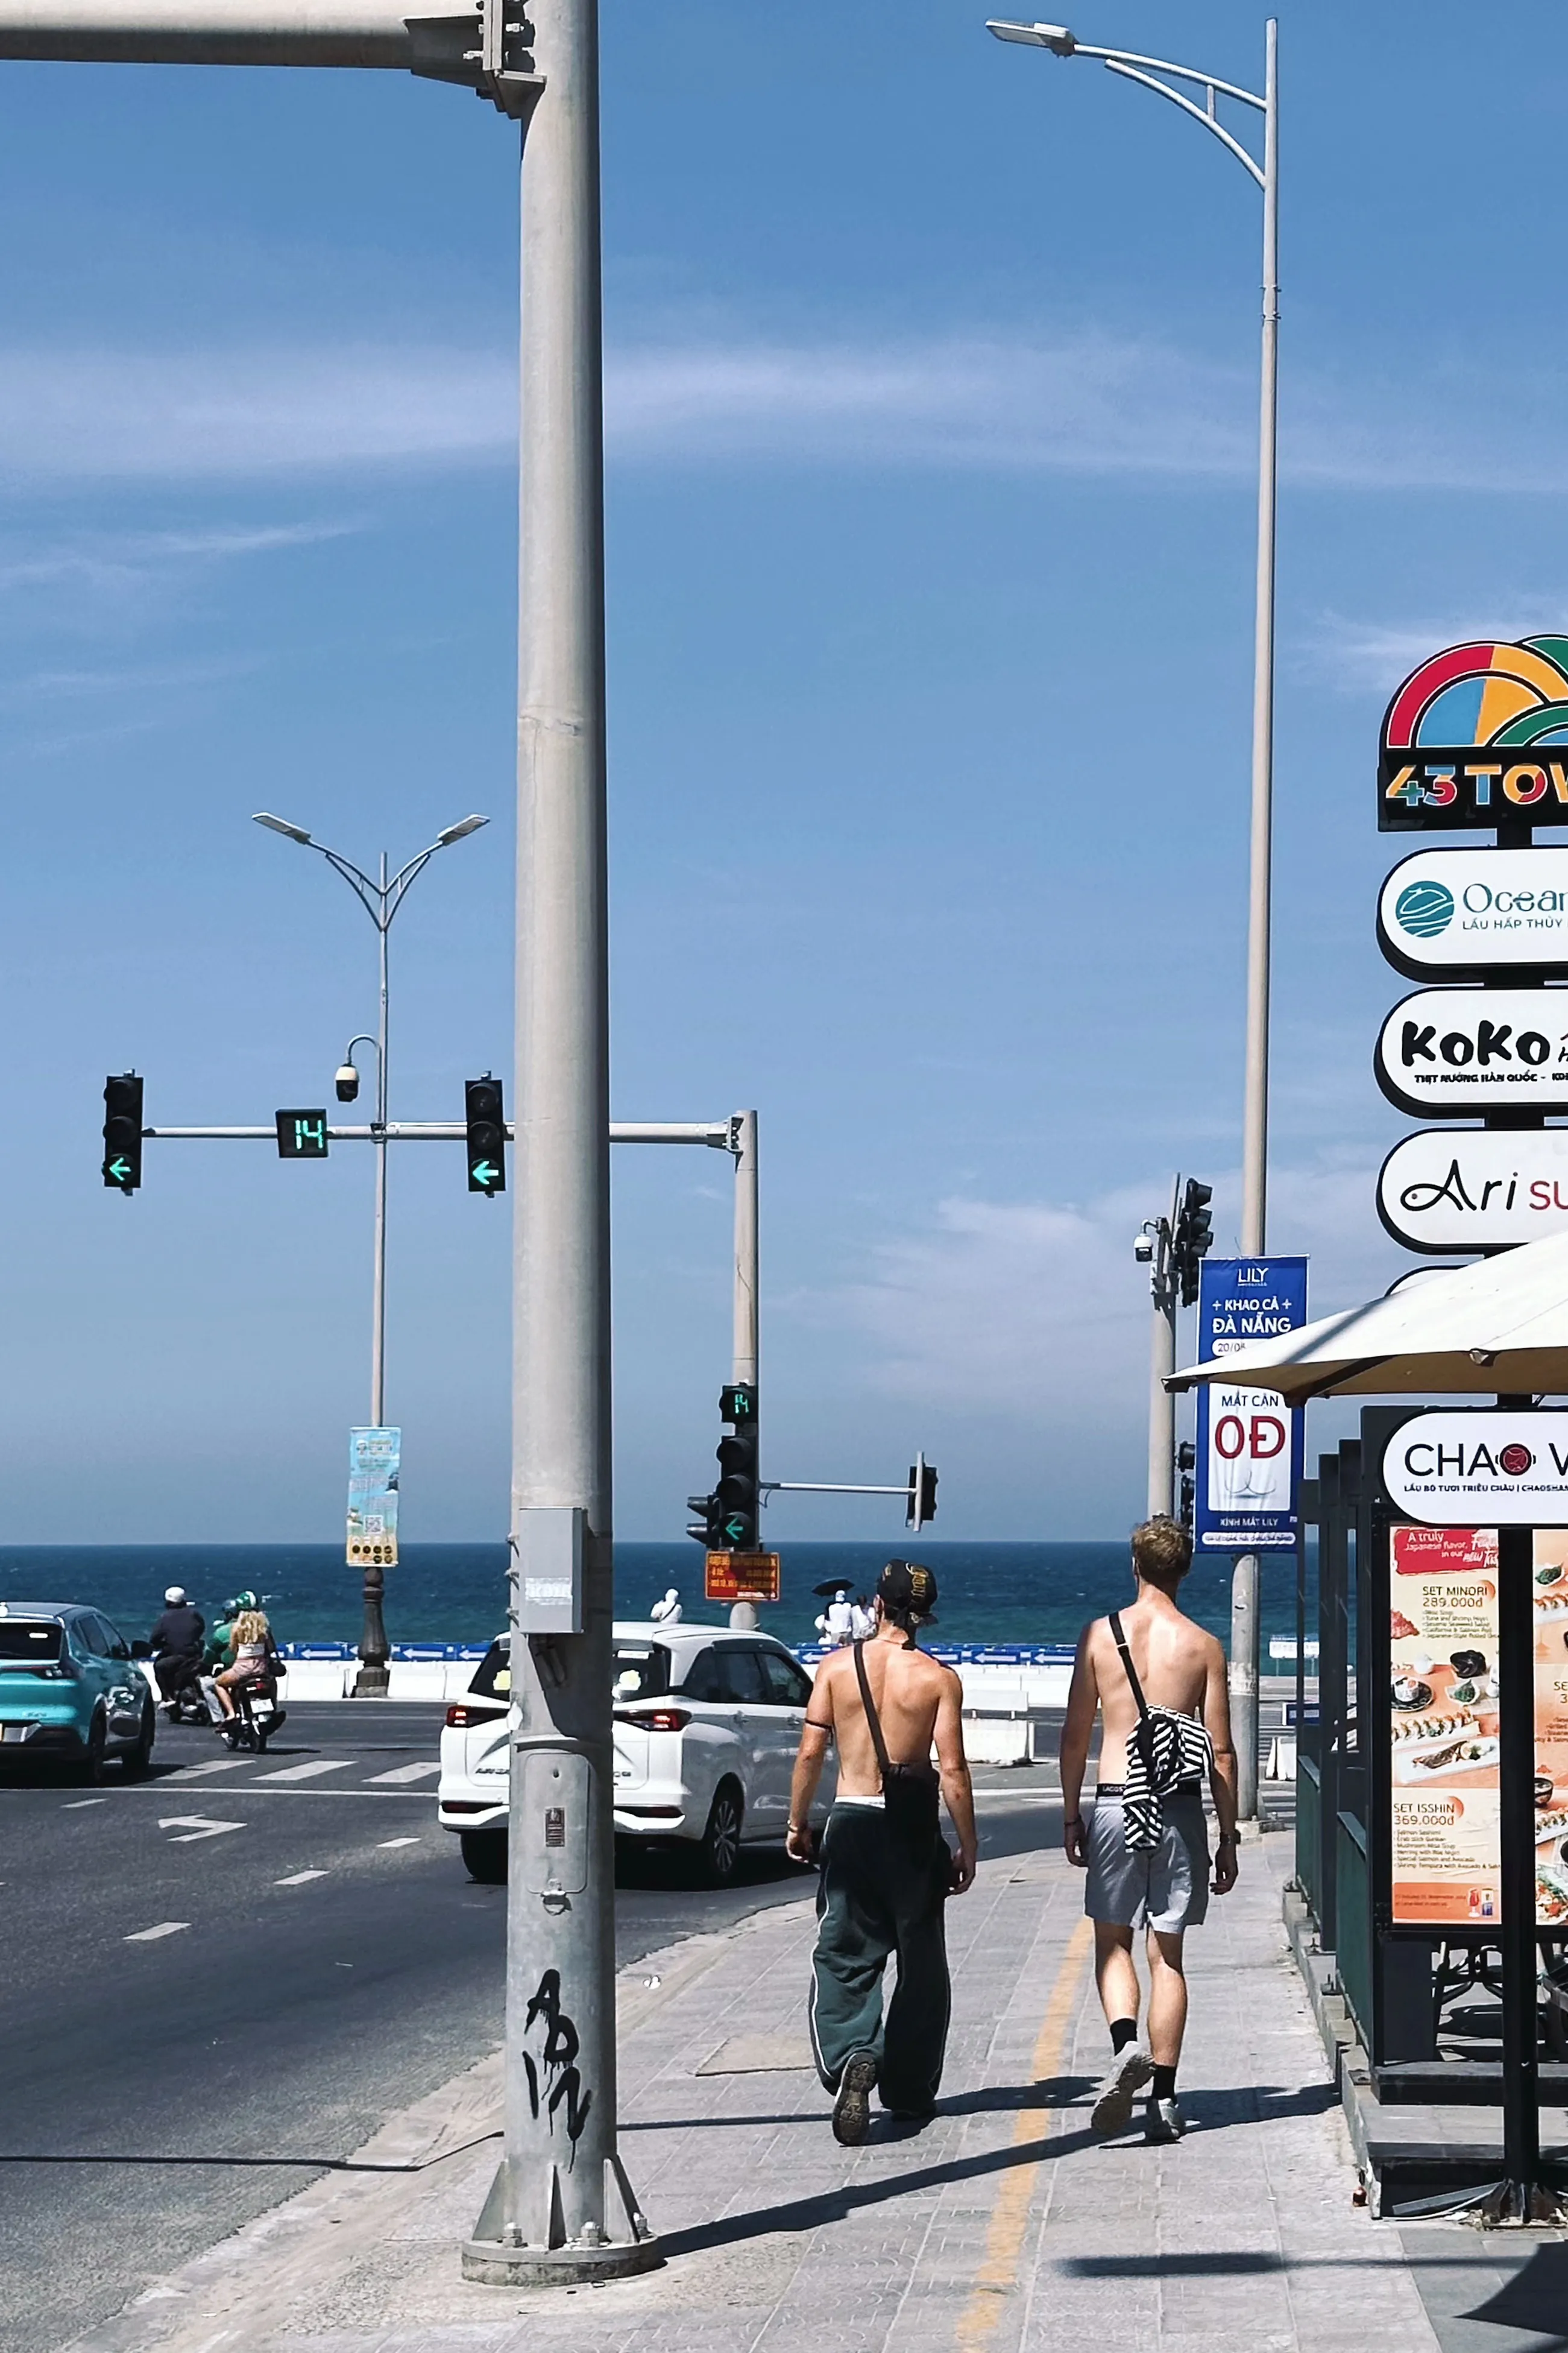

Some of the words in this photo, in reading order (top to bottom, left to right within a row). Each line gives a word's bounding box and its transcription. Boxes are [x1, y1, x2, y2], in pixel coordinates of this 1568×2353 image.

[295, 1119, 324, 1150] 14
[1238, 1267, 1270, 1283] LILY
[1224, 1298, 1260, 1311] KHAO
[1212, 1313, 1236, 1334] ĐÀ
[1408, 1532, 1416, 1543] A
[1418, 1531, 1444, 1543] truly
[1423, 1586, 1443, 1596] SET
[1446, 1586, 1487, 1596] MINORI
[1393, 1802, 1413, 1813] SET
[1417, 1803, 1455, 1813] ISSHIN
